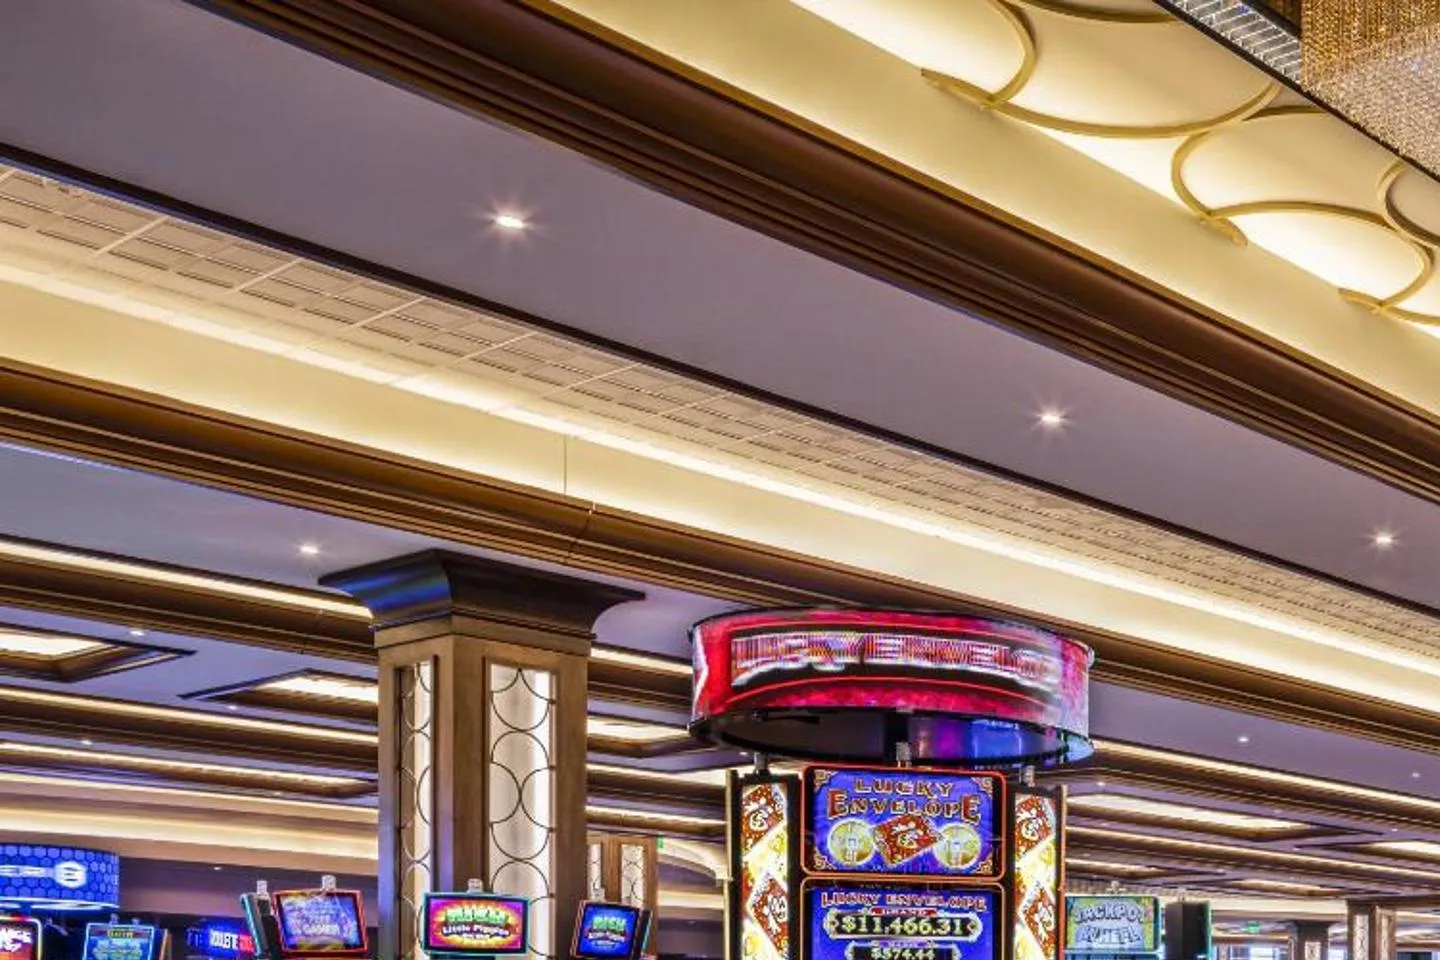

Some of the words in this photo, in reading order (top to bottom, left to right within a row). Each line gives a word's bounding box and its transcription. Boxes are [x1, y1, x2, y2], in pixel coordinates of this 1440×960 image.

[853, 775, 956, 799] LUCKY
[827, 788, 982, 824] ENVELOPE
[821, 892, 881, 908] LUCKY
[885, 893, 987, 912] ENVELOPE
[841, 915, 963, 936] $11,466.31
